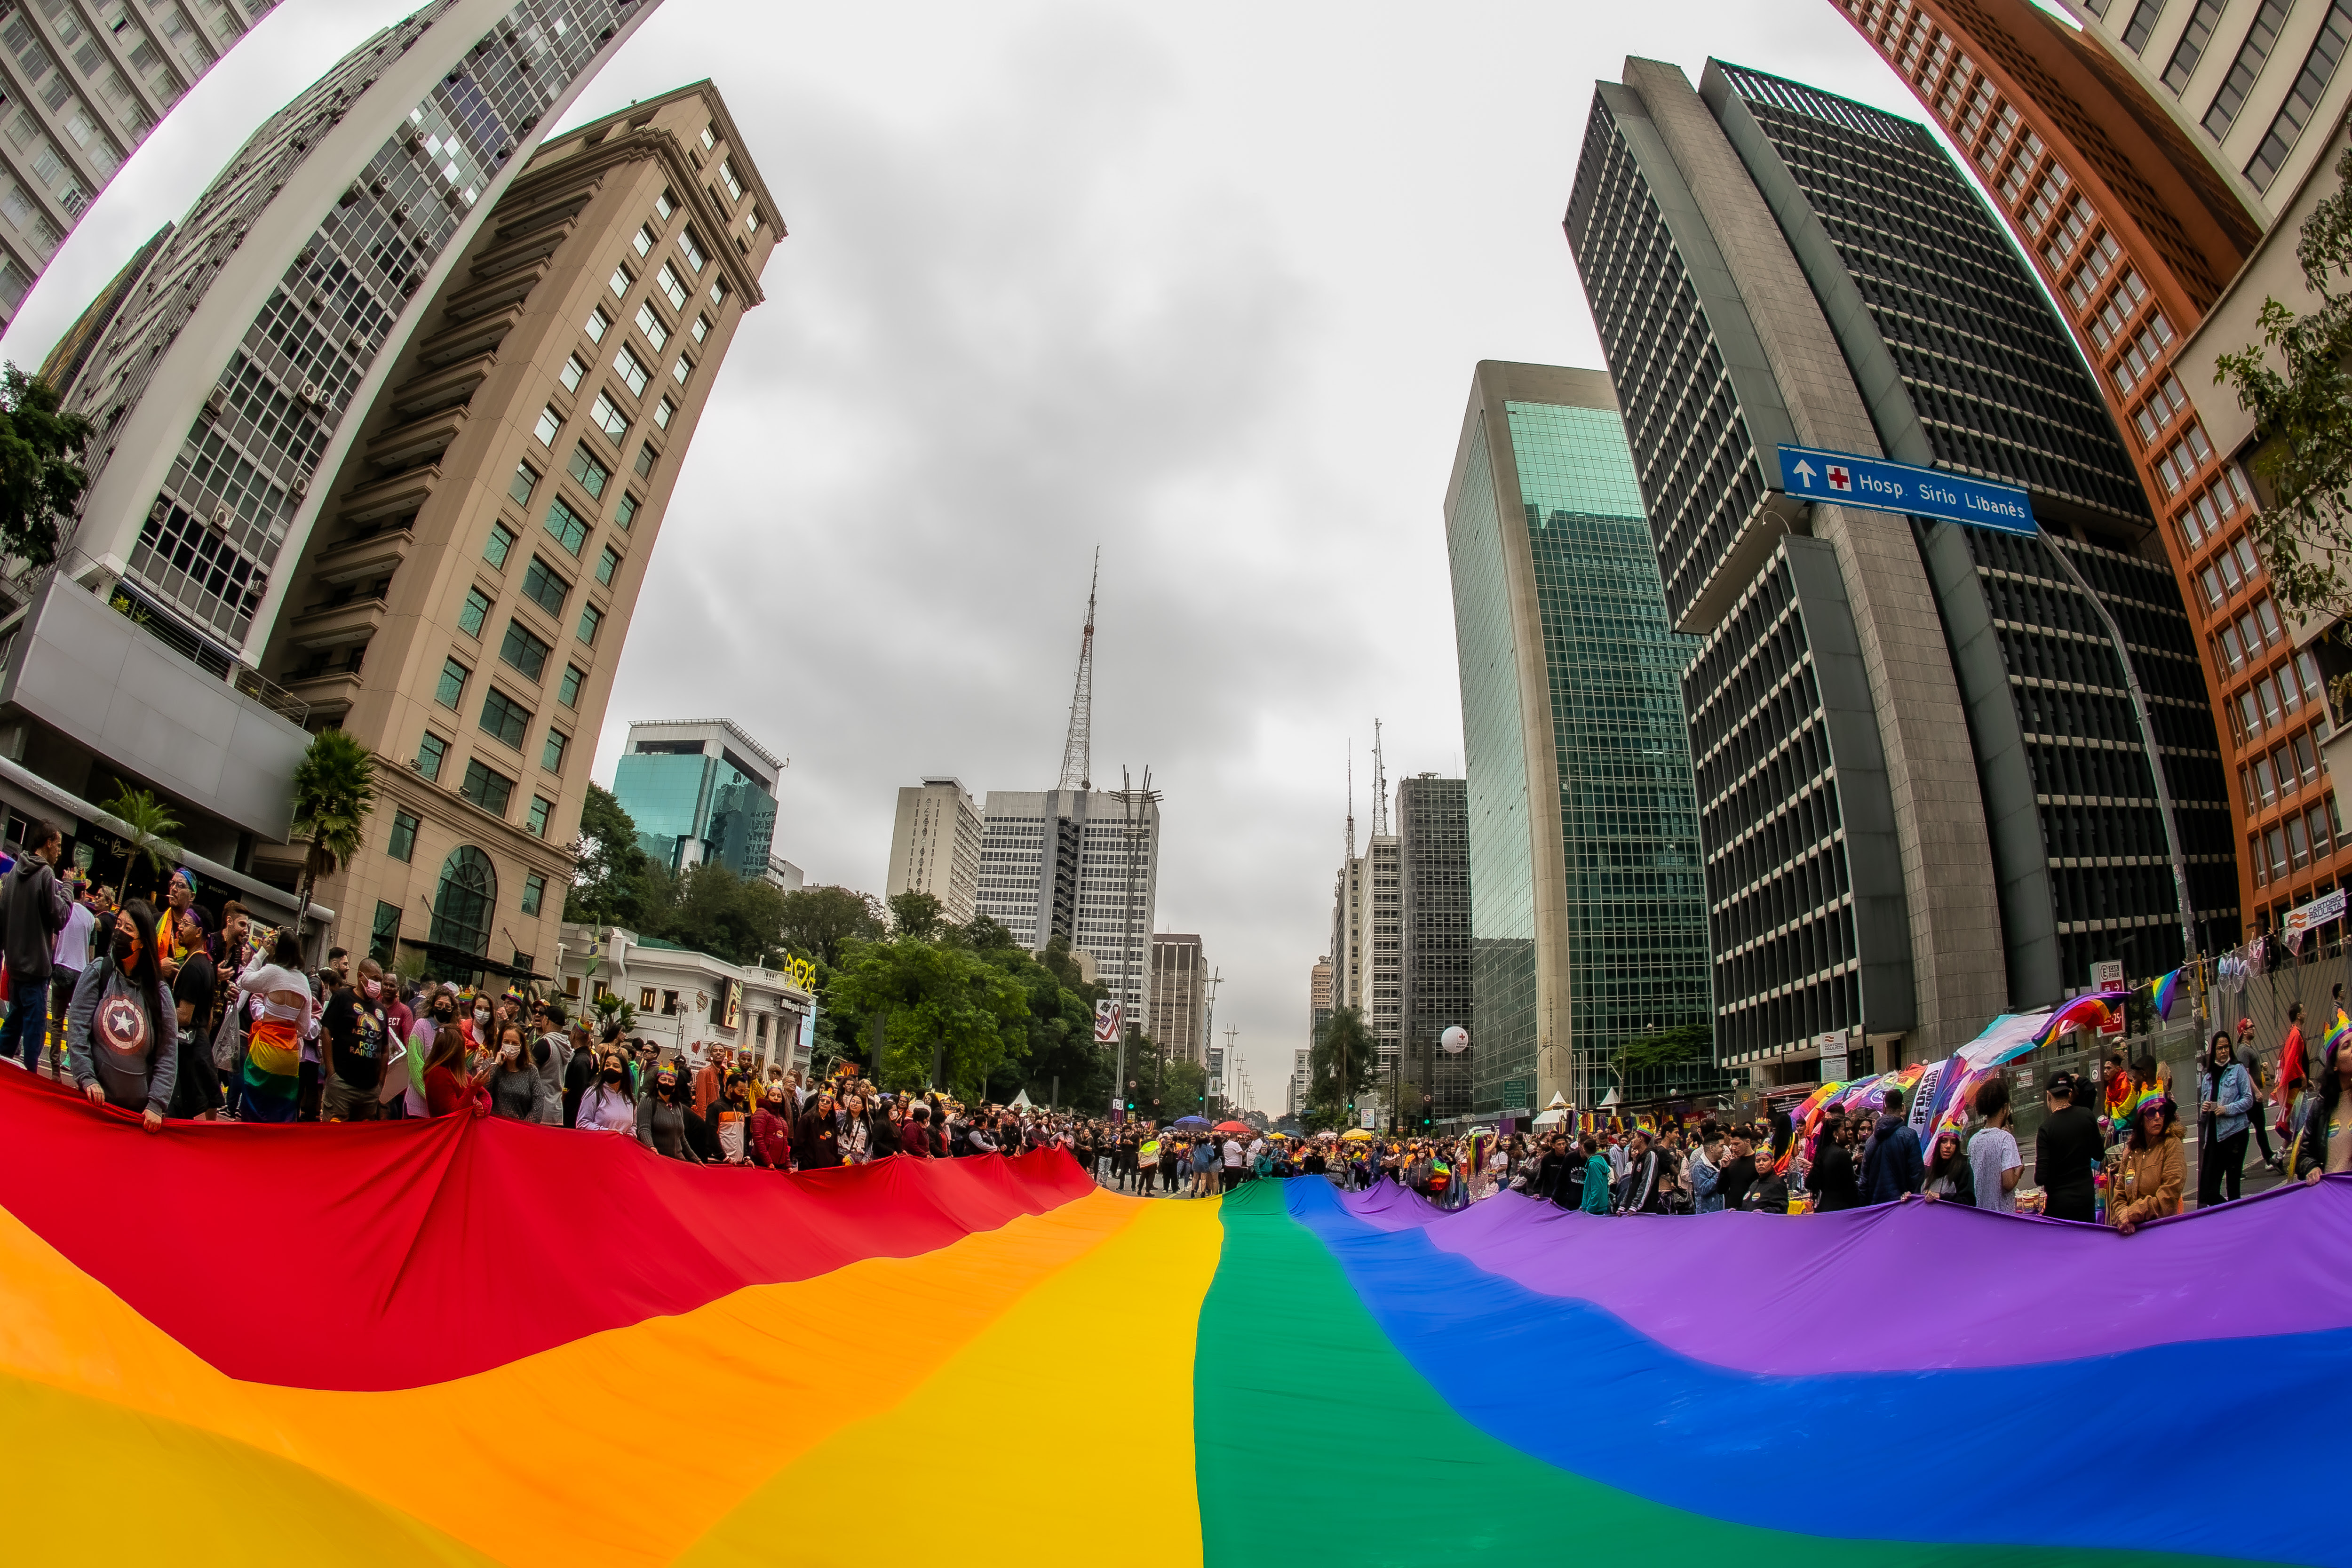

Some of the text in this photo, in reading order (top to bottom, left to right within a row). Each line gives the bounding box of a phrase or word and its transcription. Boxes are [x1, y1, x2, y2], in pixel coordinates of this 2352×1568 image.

[1859, 474, 2026, 518] Hosp. Sírio Libanês
[95, 835, 108, 845] CASA
[208, 884, 228, 896] BISCOTTI
[2308, 895, 2341, 914] CARTÓRIO
[2309, 902, 2342, 921] PAULISTA
[2103, 968, 2106, 977] E
[781, 998, 800, 1013] Méqui
[352, 1027, 382, 1040] KEEP CA
[350, 1046, 381, 1059] RAINBO
